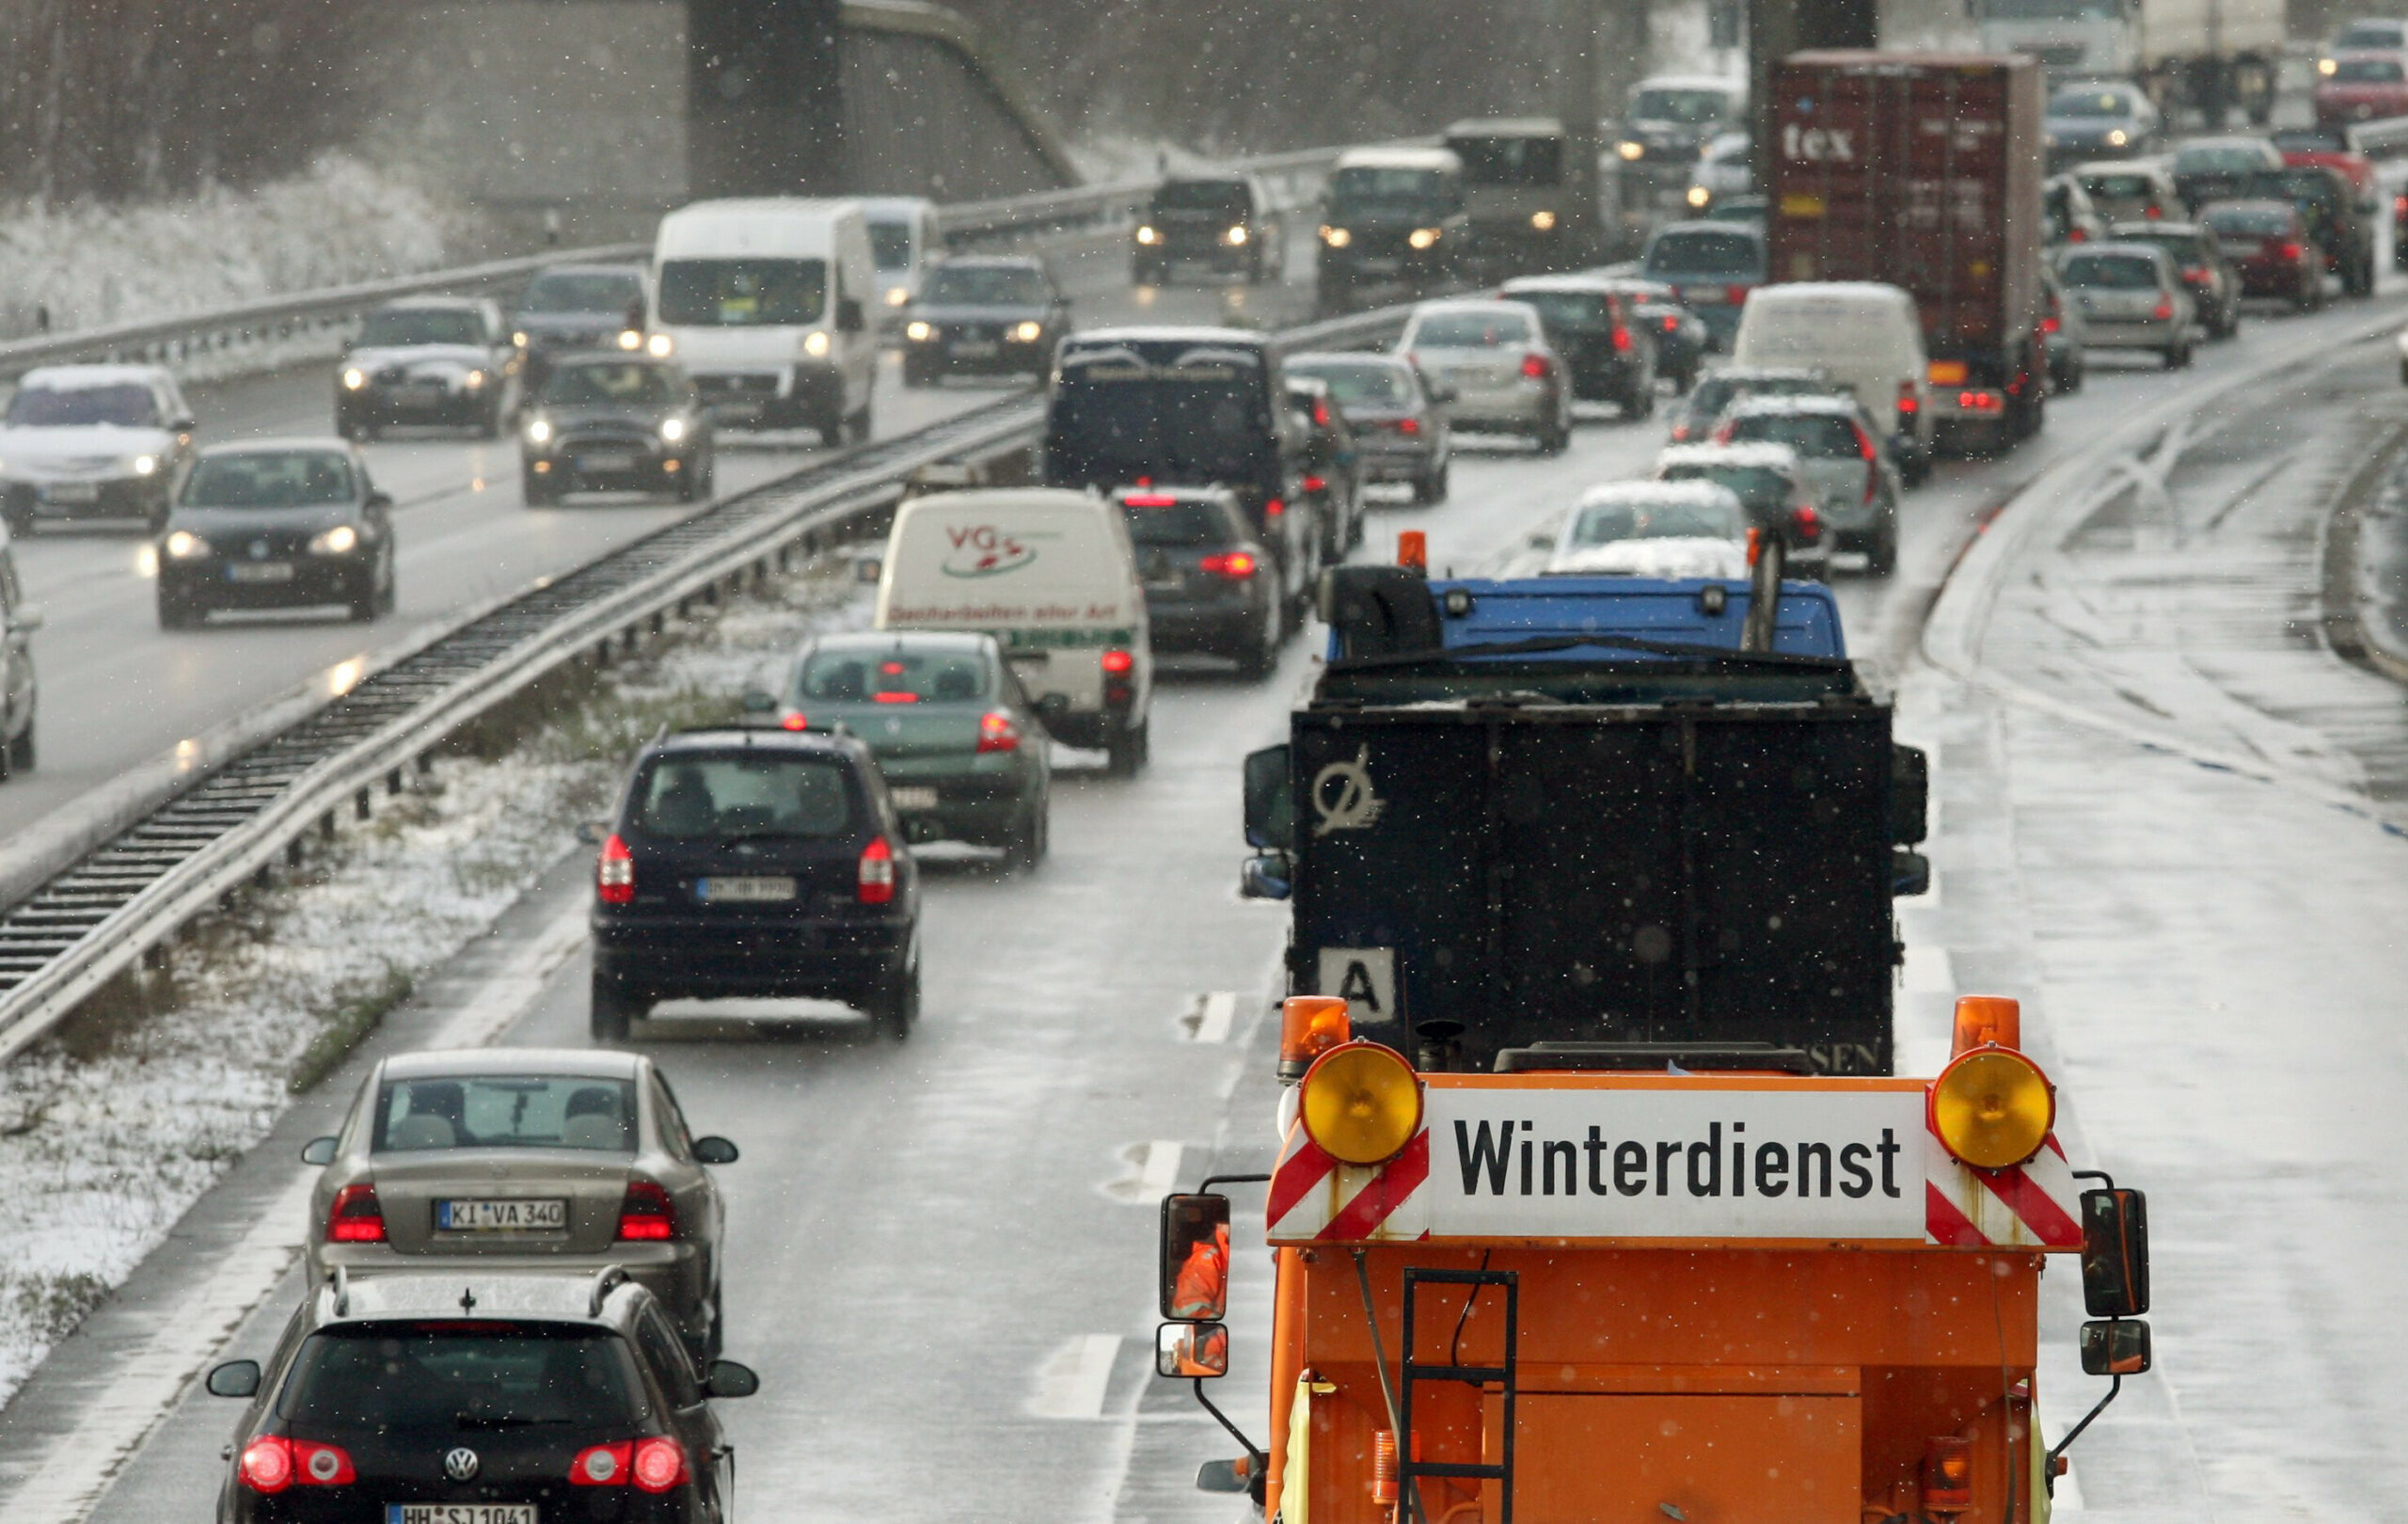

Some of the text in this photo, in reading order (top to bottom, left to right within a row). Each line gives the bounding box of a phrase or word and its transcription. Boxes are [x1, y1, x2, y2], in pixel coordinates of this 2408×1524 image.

[1782, 123, 1854, 161] tex
[1339, 960, 1381, 1012] A
[1454, 1119, 1901, 1199] Winterdienst
[452, 1203, 561, 1224] KI VA 340
